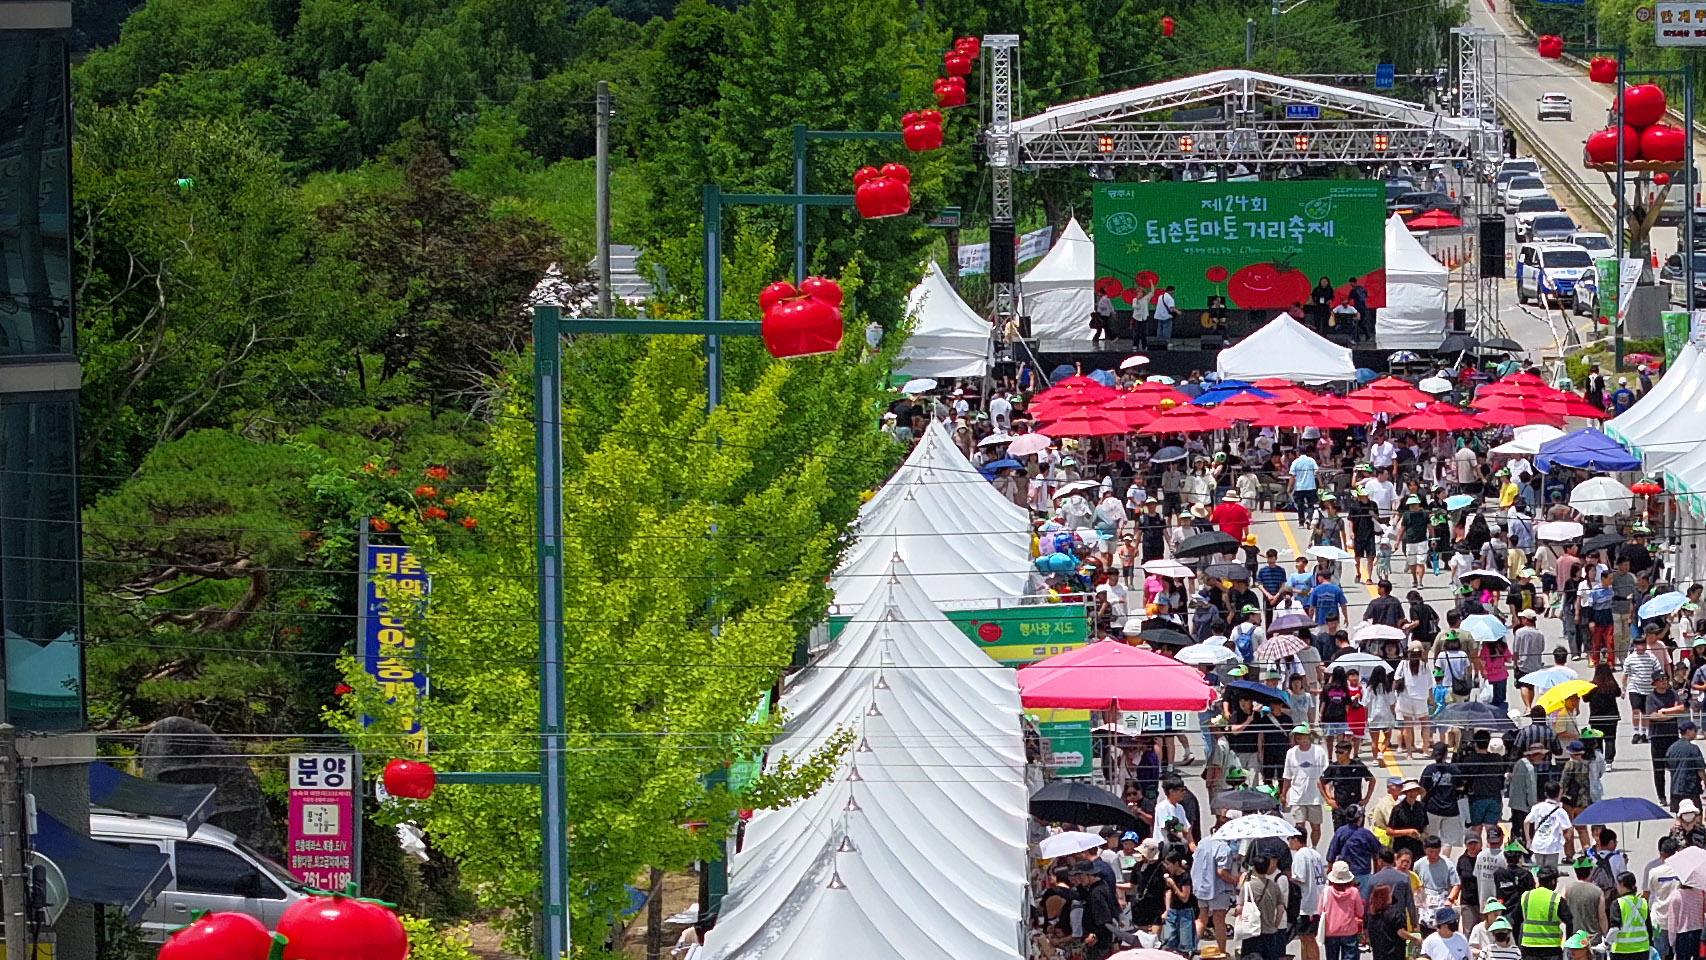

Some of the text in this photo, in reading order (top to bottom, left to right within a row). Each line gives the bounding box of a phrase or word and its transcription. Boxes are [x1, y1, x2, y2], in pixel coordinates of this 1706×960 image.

[1201, 194, 1267, 213] 제24회
[375, 552, 421, 575] 퇴촌
[1020, 621, 1075, 636] 행사장 지도
[297, 757, 346, 787] 분양
